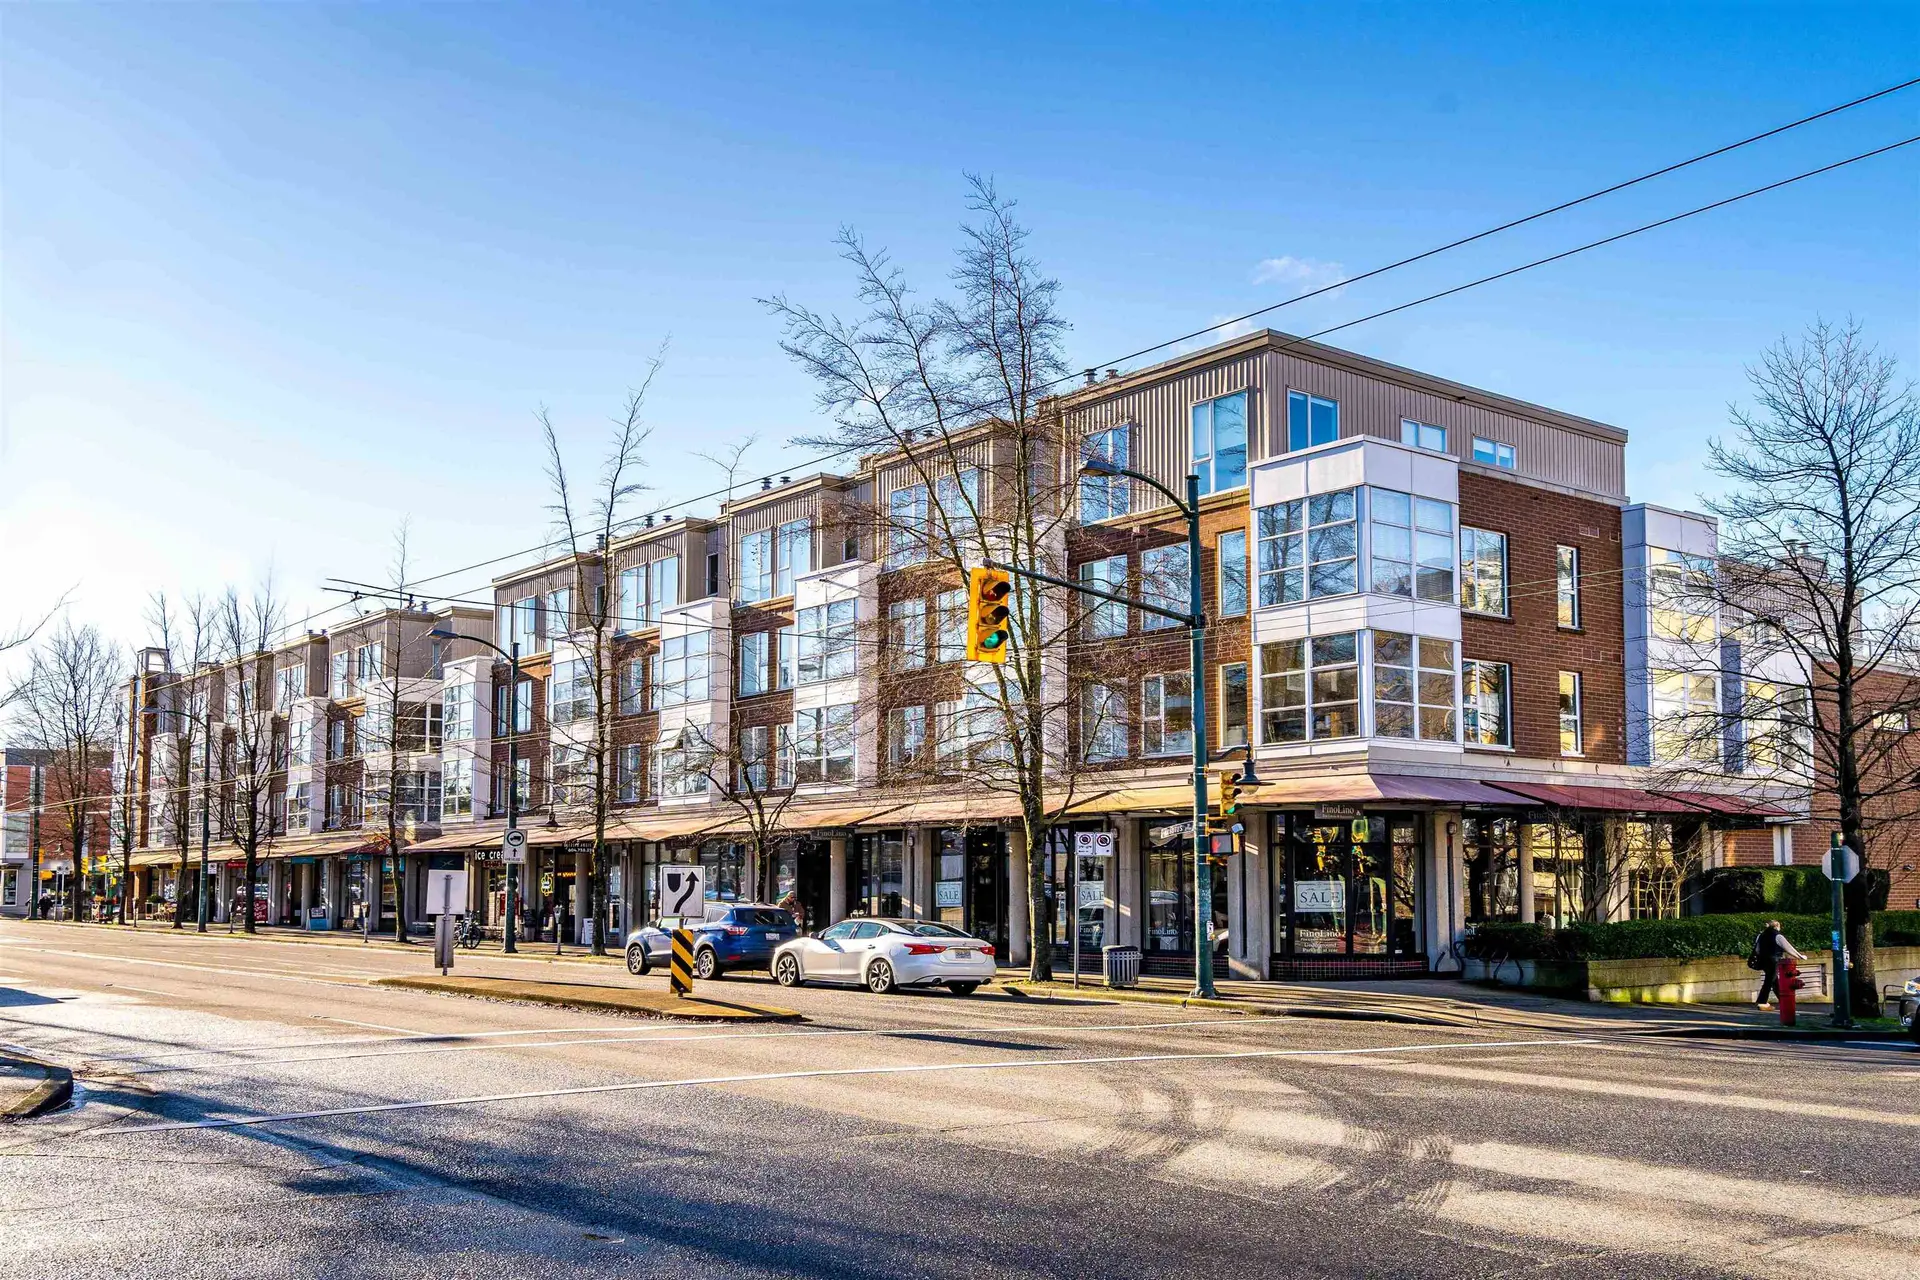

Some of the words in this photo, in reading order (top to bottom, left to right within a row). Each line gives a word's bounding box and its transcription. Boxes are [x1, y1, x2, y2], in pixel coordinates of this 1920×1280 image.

[474, 850, 486, 861] ice
[488, 850, 505, 860] crea
[939, 890, 960, 900] SALE
[1299, 891, 1341, 903] SALE
[1299, 929, 1342, 938] FinoLino
